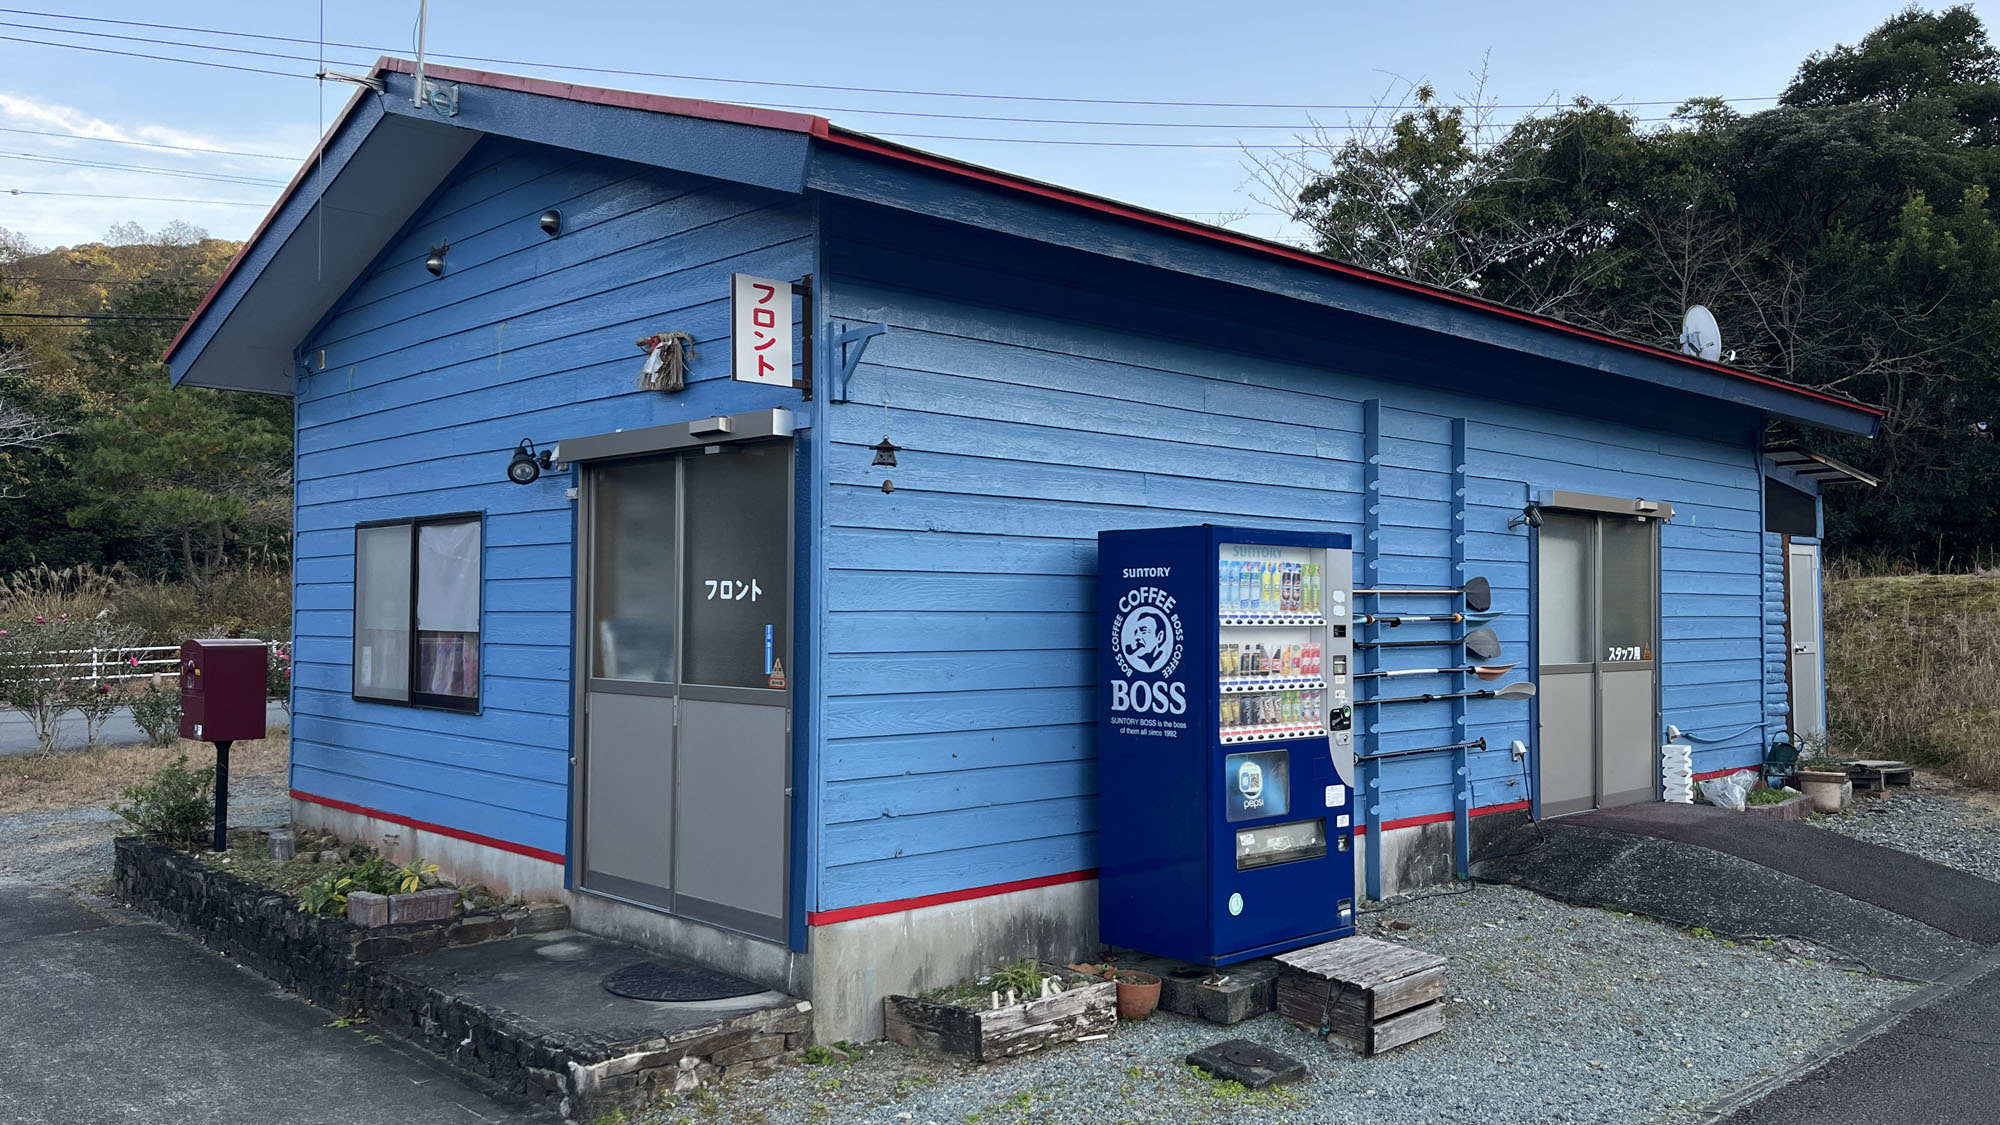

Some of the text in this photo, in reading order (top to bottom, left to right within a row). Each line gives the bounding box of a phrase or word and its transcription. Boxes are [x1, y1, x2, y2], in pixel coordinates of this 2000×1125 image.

[752, 283, 777, 377] フロント
[1232, 545, 1283, 559] SUNTORY
[1122, 566, 1171, 578] SUNTORY
[705, 578, 762, 602] フロント
[1118, 586, 1176, 613] COFFEE
[1111, 613, 1133, 677] BOSS COFFEE
[1162, 613, 1184, 679] BOSS COFFEE
[1608, 646, 1640, 661] スタッフ用
[1110, 679, 1187, 715] BOSS
[1110, 716, 1139, 726] SUNTORY
[1139, 718, 1157, 727] BOSS
[1163, 720, 1172, 728] the
[1173, 721, 1187, 729] boss
[1119, 726, 1126, 734] of
[1126, 727, 1140, 735] them
[1140, 728, 1148, 736] all
[1163, 730, 1177, 738] 1992
[1243, 797, 1264, 810] pepsi
